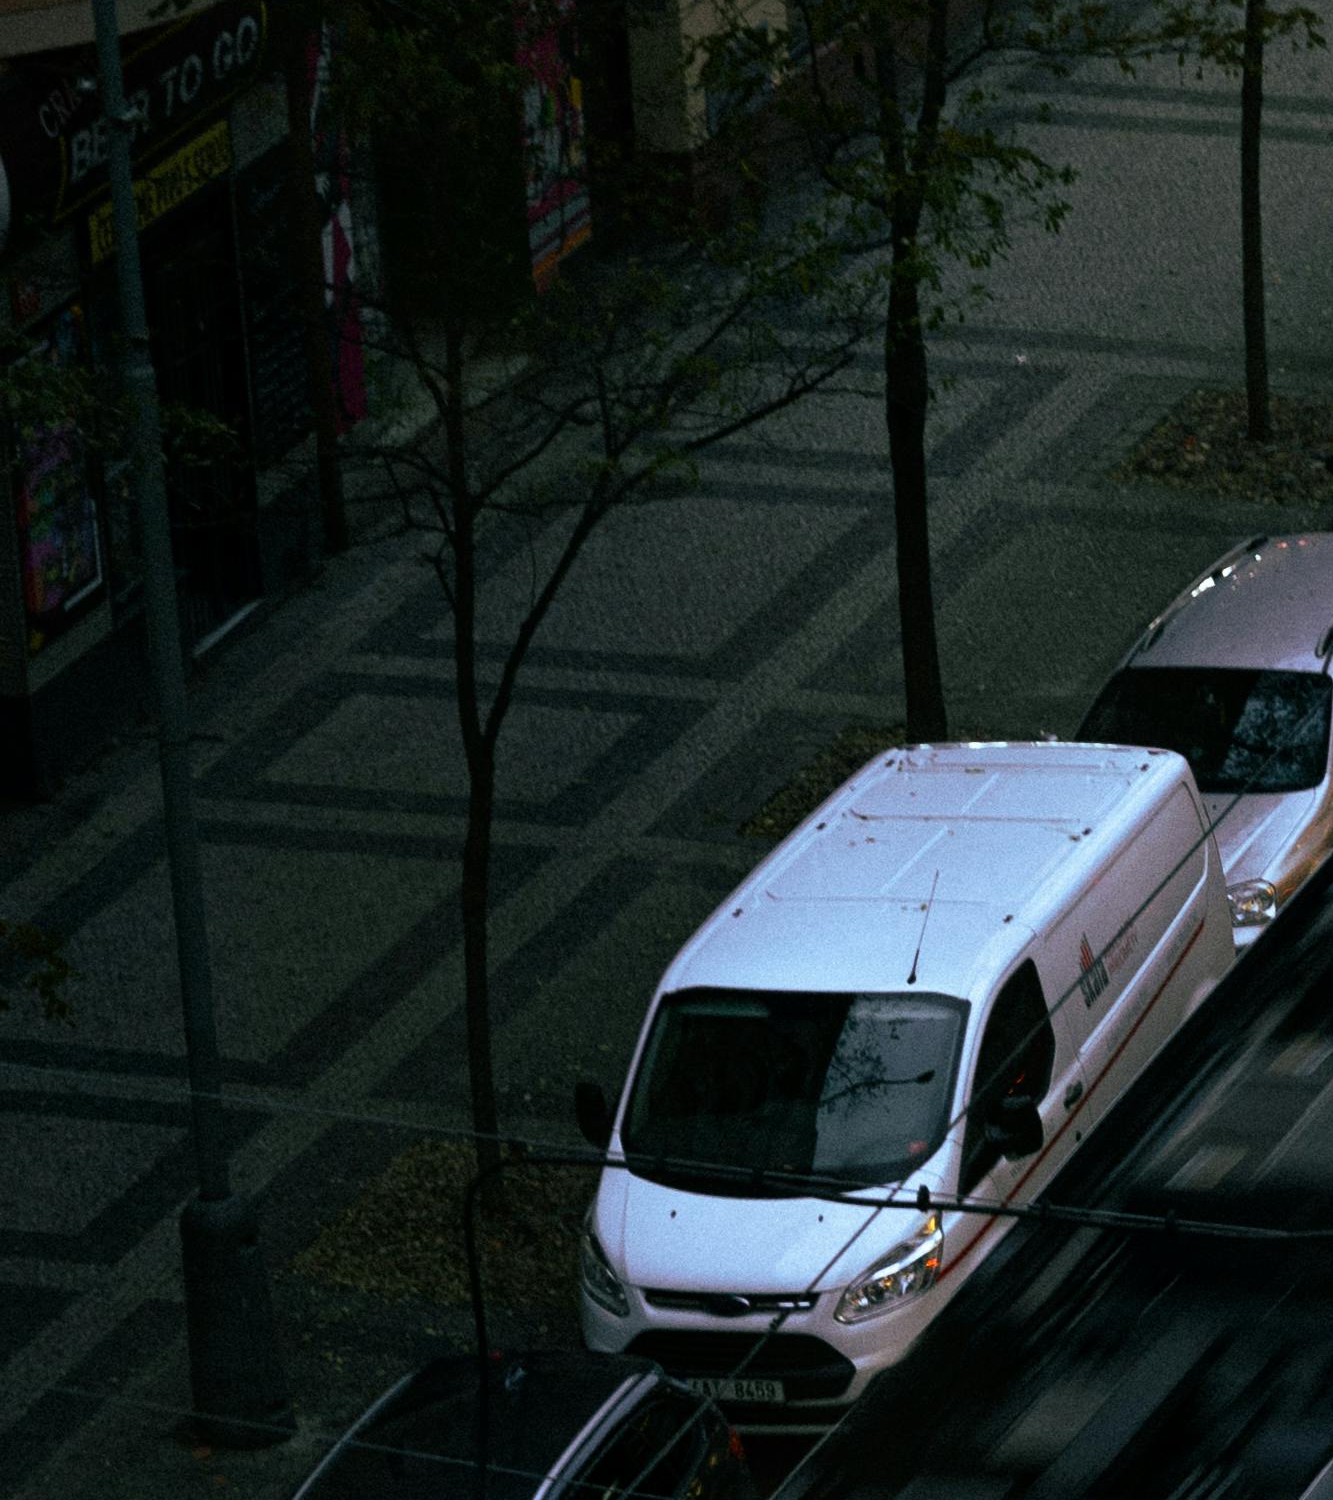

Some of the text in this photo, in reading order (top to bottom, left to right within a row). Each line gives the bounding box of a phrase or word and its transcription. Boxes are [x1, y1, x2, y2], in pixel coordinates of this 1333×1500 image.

[70, 14, 260, 184] BER TO GO
